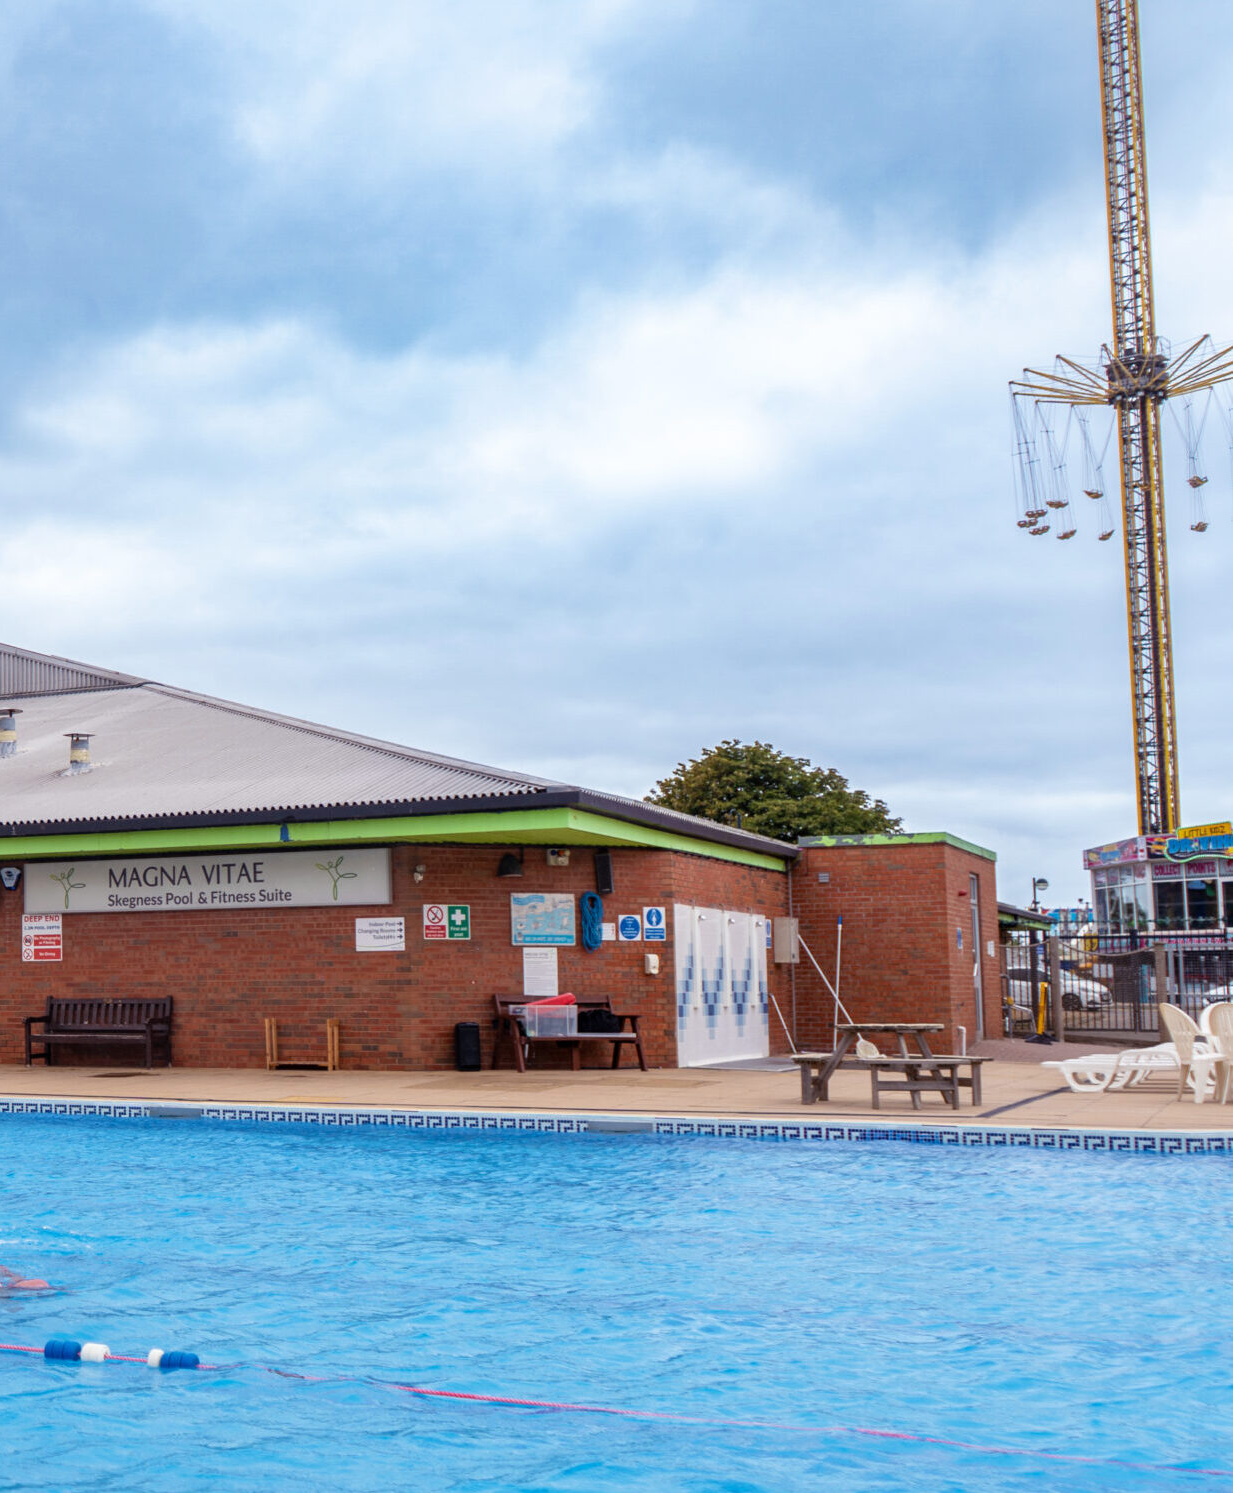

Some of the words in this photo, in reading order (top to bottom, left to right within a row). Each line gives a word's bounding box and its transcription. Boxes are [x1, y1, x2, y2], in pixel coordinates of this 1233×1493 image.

[1184, 828, 1207, 838] LITTLE
[1168, 834, 1233, 854] DRIVIN
[108, 865, 192, 888] MAGNA
[201, 862, 265, 885] VITAE
[1154, 863, 1181, 876] COLLECT
[1188, 861, 1216, 875] POINTS
[107, 894, 163, 909] Skegness
[166, 892, 193, 906] Pool
[197, 891, 208, 904] &
[210, 890, 256, 904] Fitness
[258, 889, 293, 902] Suite
